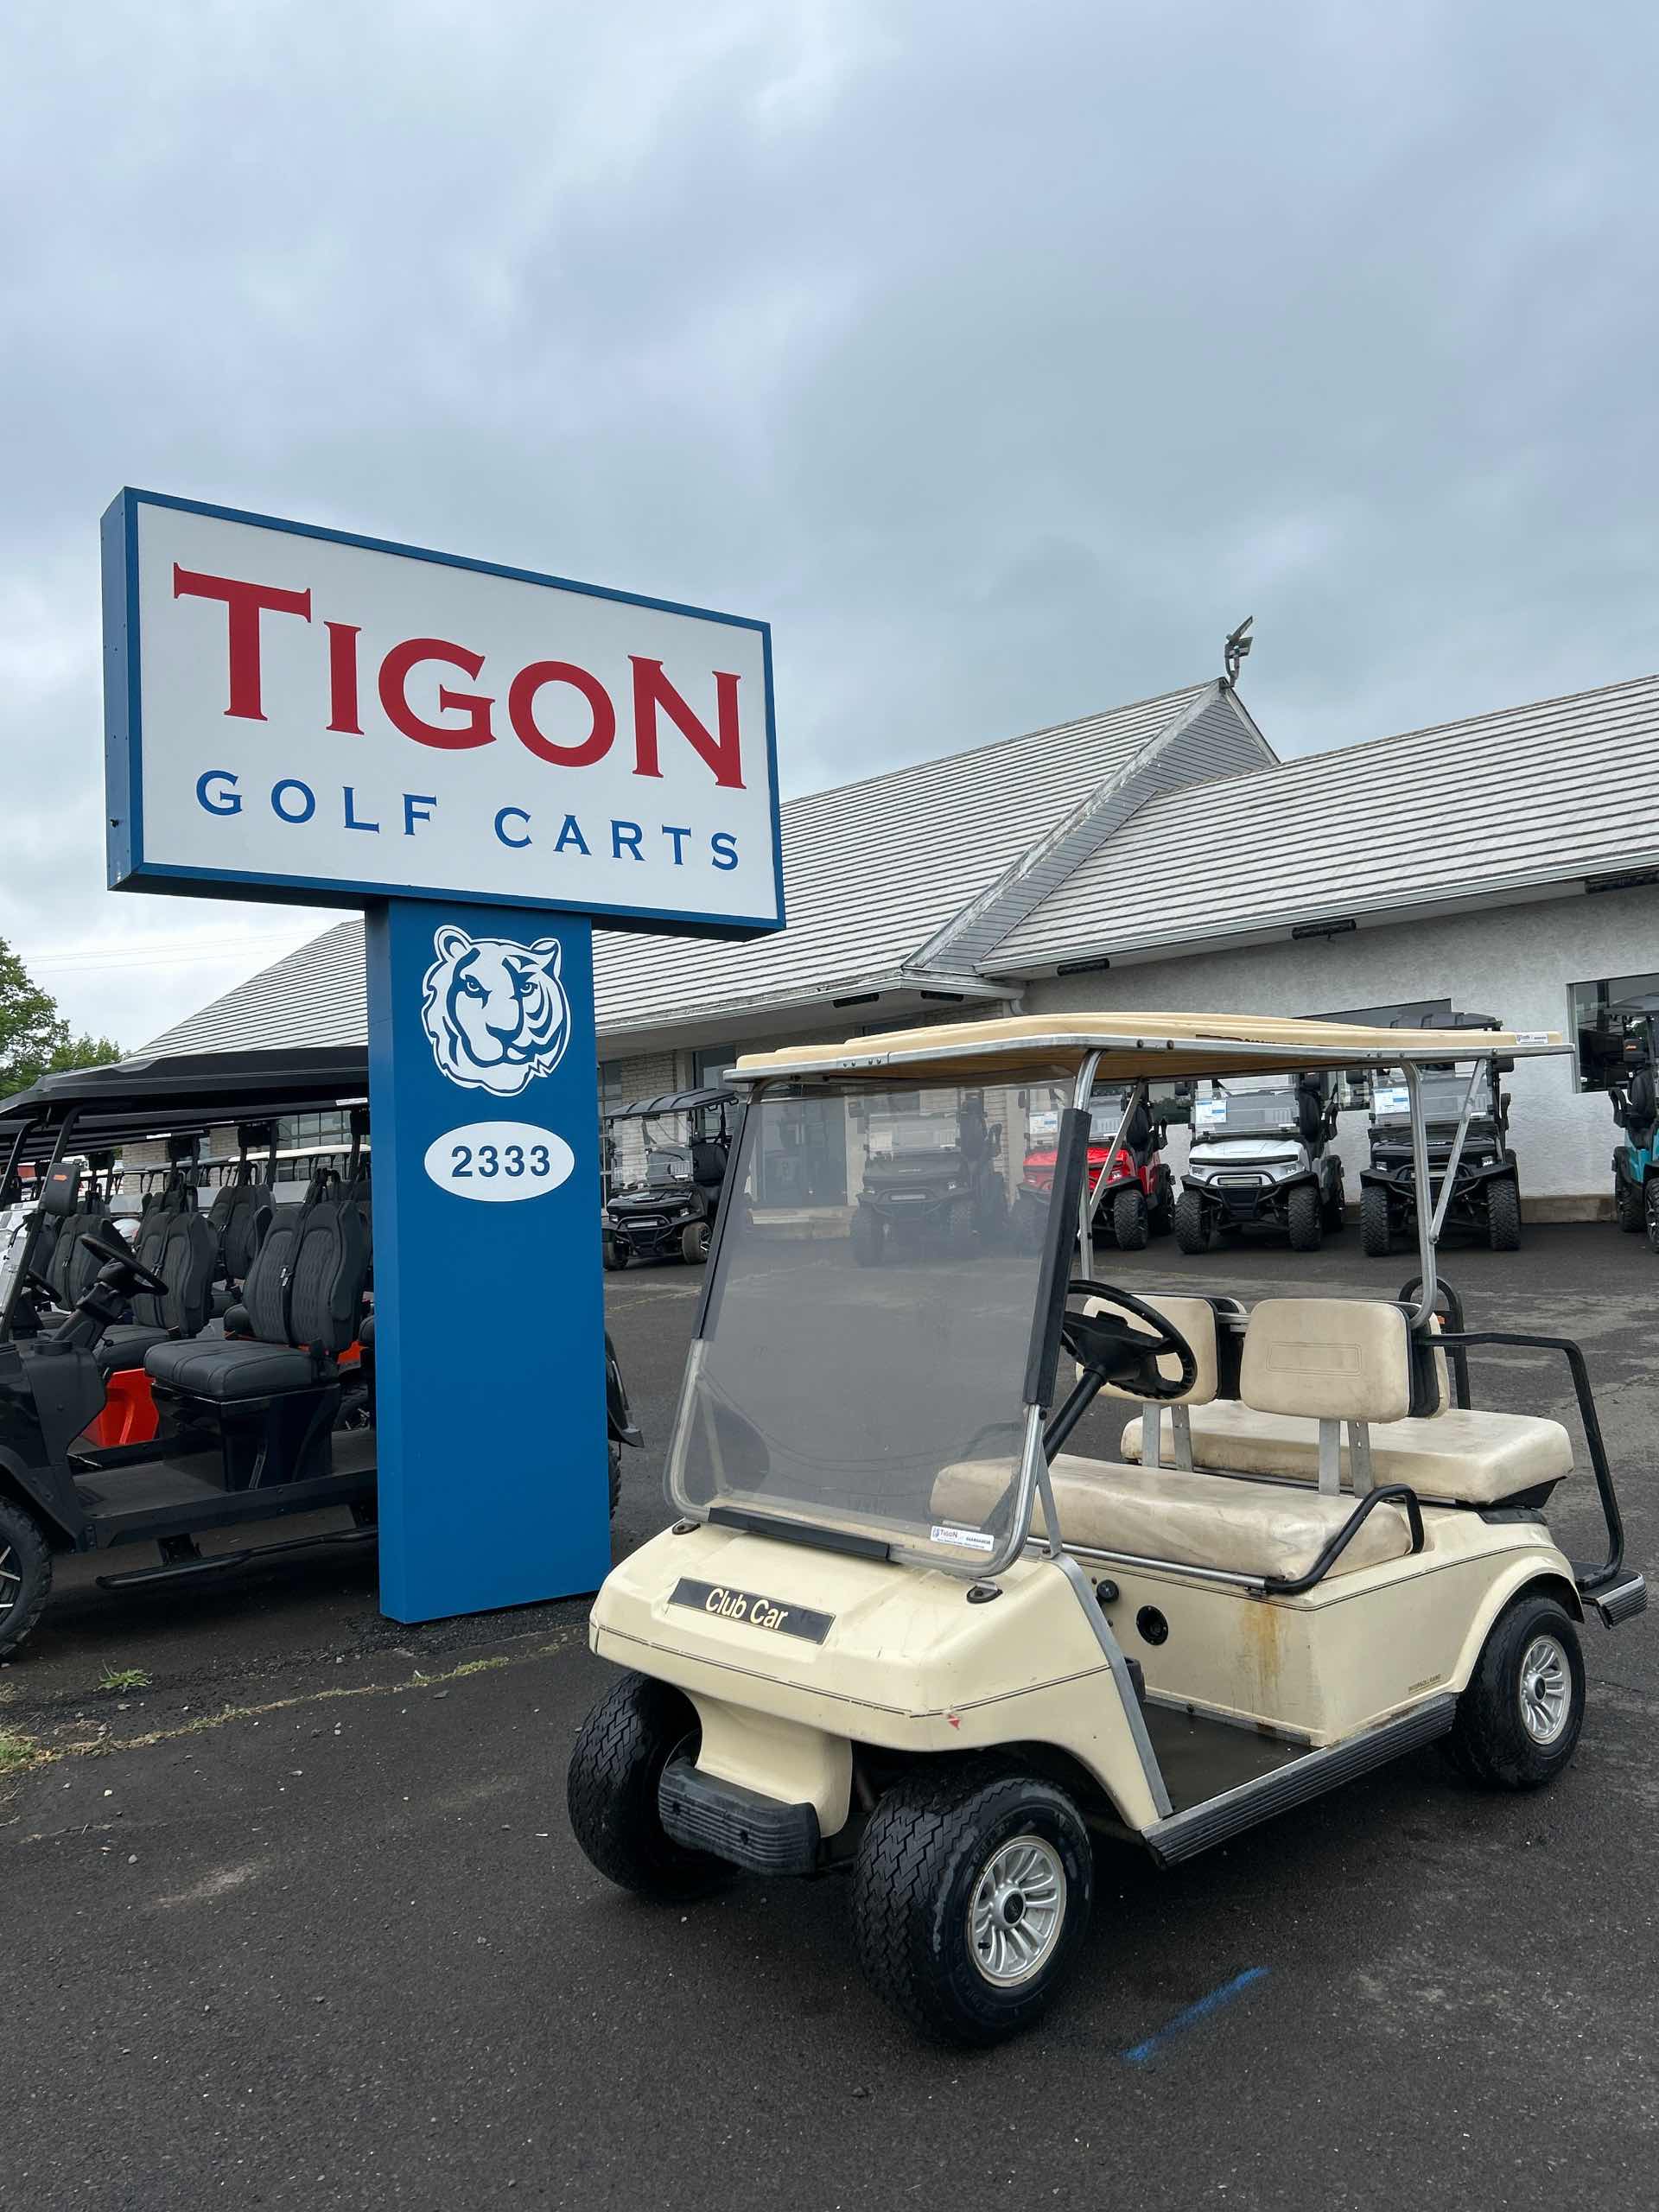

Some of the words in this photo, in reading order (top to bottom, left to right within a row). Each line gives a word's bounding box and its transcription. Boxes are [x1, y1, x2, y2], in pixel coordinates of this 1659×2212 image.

[174, 563, 747, 789] TIGON
[196, 770, 437, 836] GOLF
[494, 807, 739, 871] CARTS
[451, 1146, 551, 1178] 2333
[705, 1587, 747, 1618] Club
[750, 1599, 788, 1630] Car
